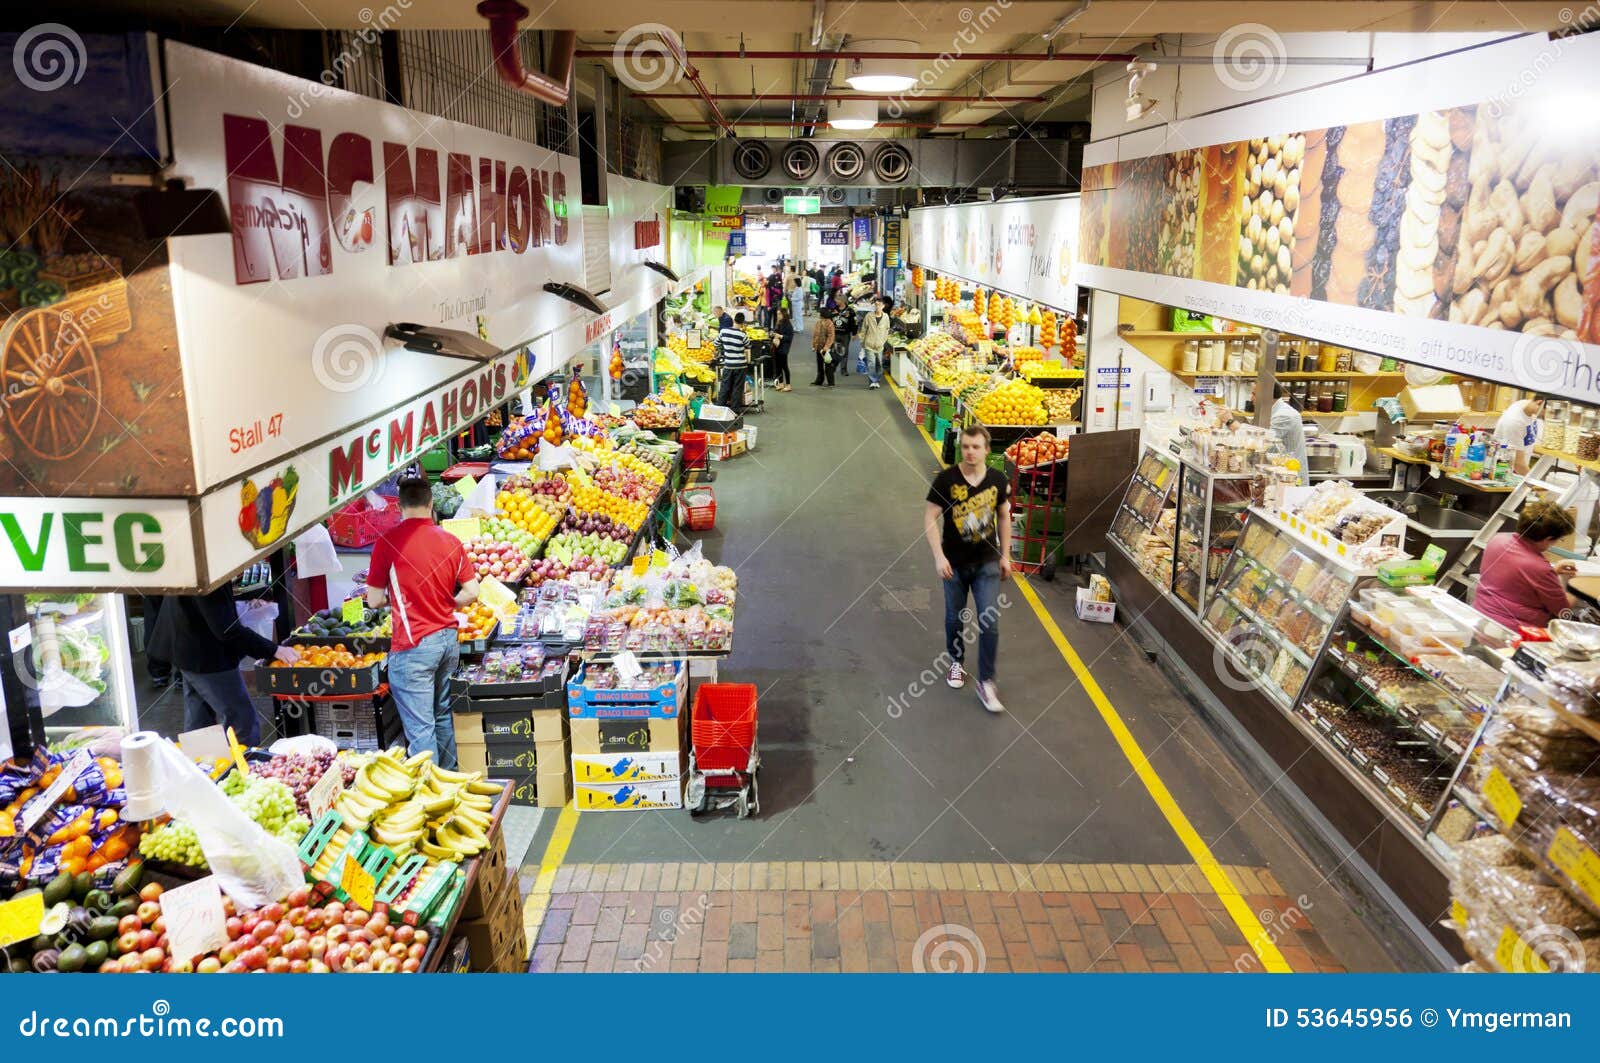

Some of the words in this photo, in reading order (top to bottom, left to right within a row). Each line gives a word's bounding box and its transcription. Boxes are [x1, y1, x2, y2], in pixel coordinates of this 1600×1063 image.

[824, 231, 837, 239] LIFT
[1421, 338, 1443, 360] gift
[228, 421, 263, 454] Stall
[267, 413, 284, 438] 47
[0, 512, 166, 573] VEG
